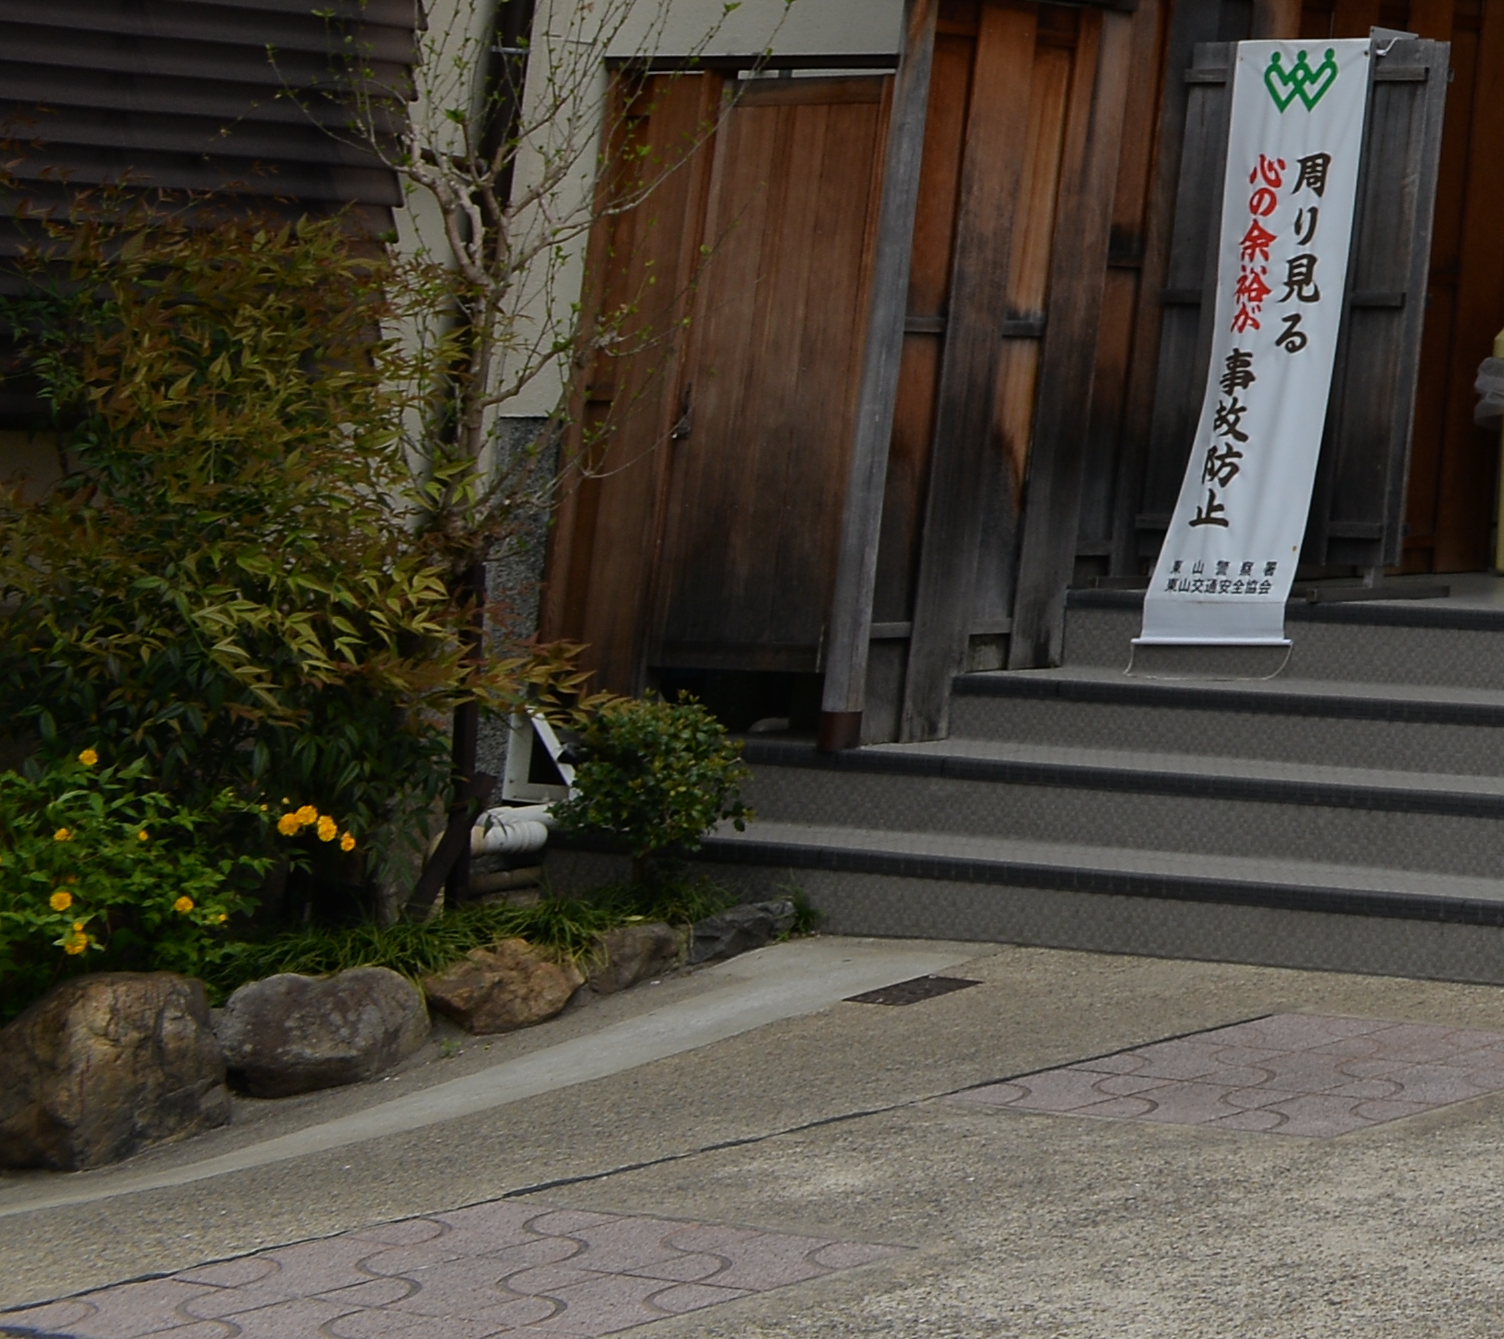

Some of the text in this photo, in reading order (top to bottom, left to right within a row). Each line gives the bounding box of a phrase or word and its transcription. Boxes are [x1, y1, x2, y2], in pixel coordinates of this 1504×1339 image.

[1188, 153, 1287, 530] 心の余裕が 事故防止
[1274, 151, 1333, 355] 周り見る
[1164, 577, 1273, 595] 東山交通安全協会
